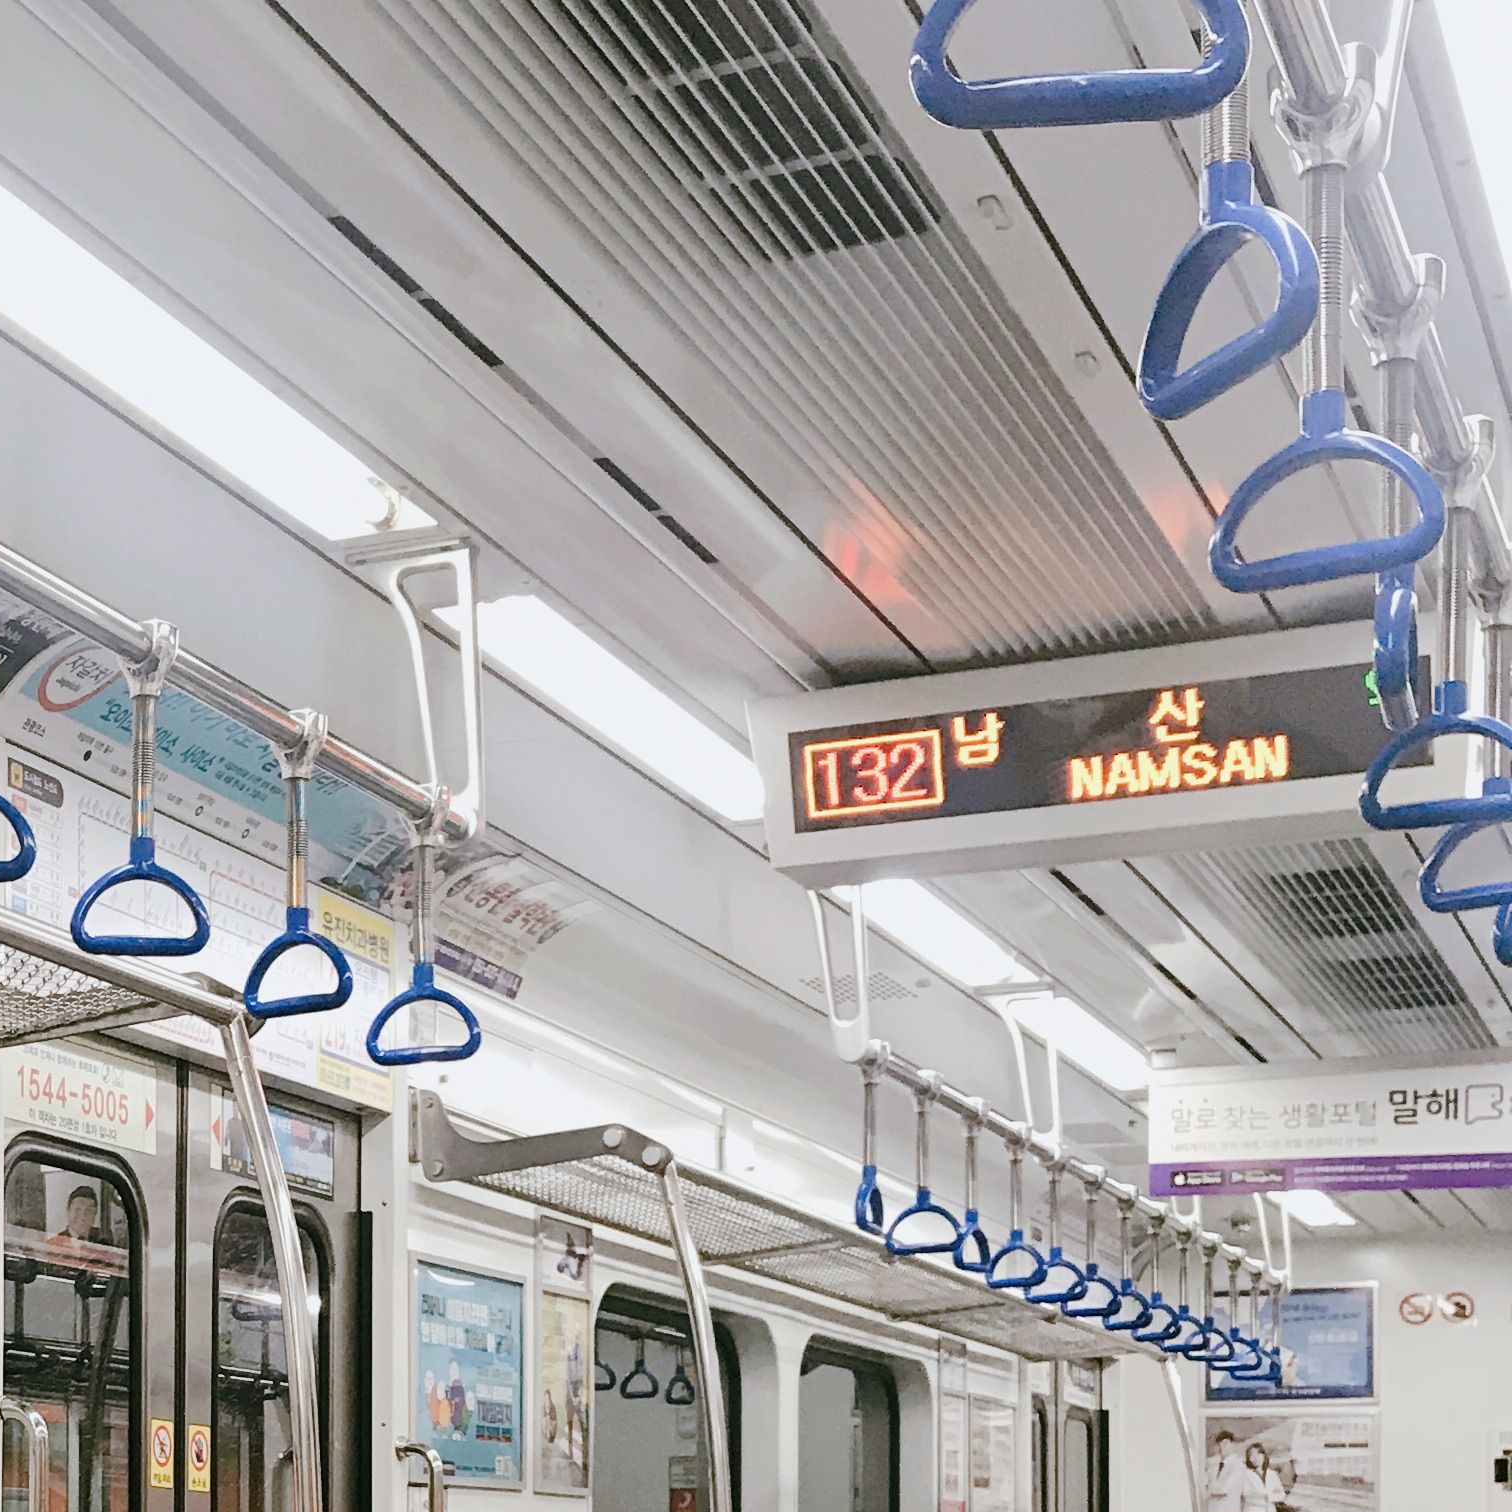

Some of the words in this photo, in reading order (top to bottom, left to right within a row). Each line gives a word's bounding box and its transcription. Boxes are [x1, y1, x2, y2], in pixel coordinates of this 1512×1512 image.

[66, 655, 114, 684] 자갈치
[816, 741, 929, 809] 132
[1068, 734, 1289, 802] NAMSAN
[322, 911, 389, 964] 유진치과병원
[18, 1065, 129, 1125] 1544-5005
[1171, 1106, 1216, 1134] 말로
[1225, 1105, 1271, 1130] 찾는
